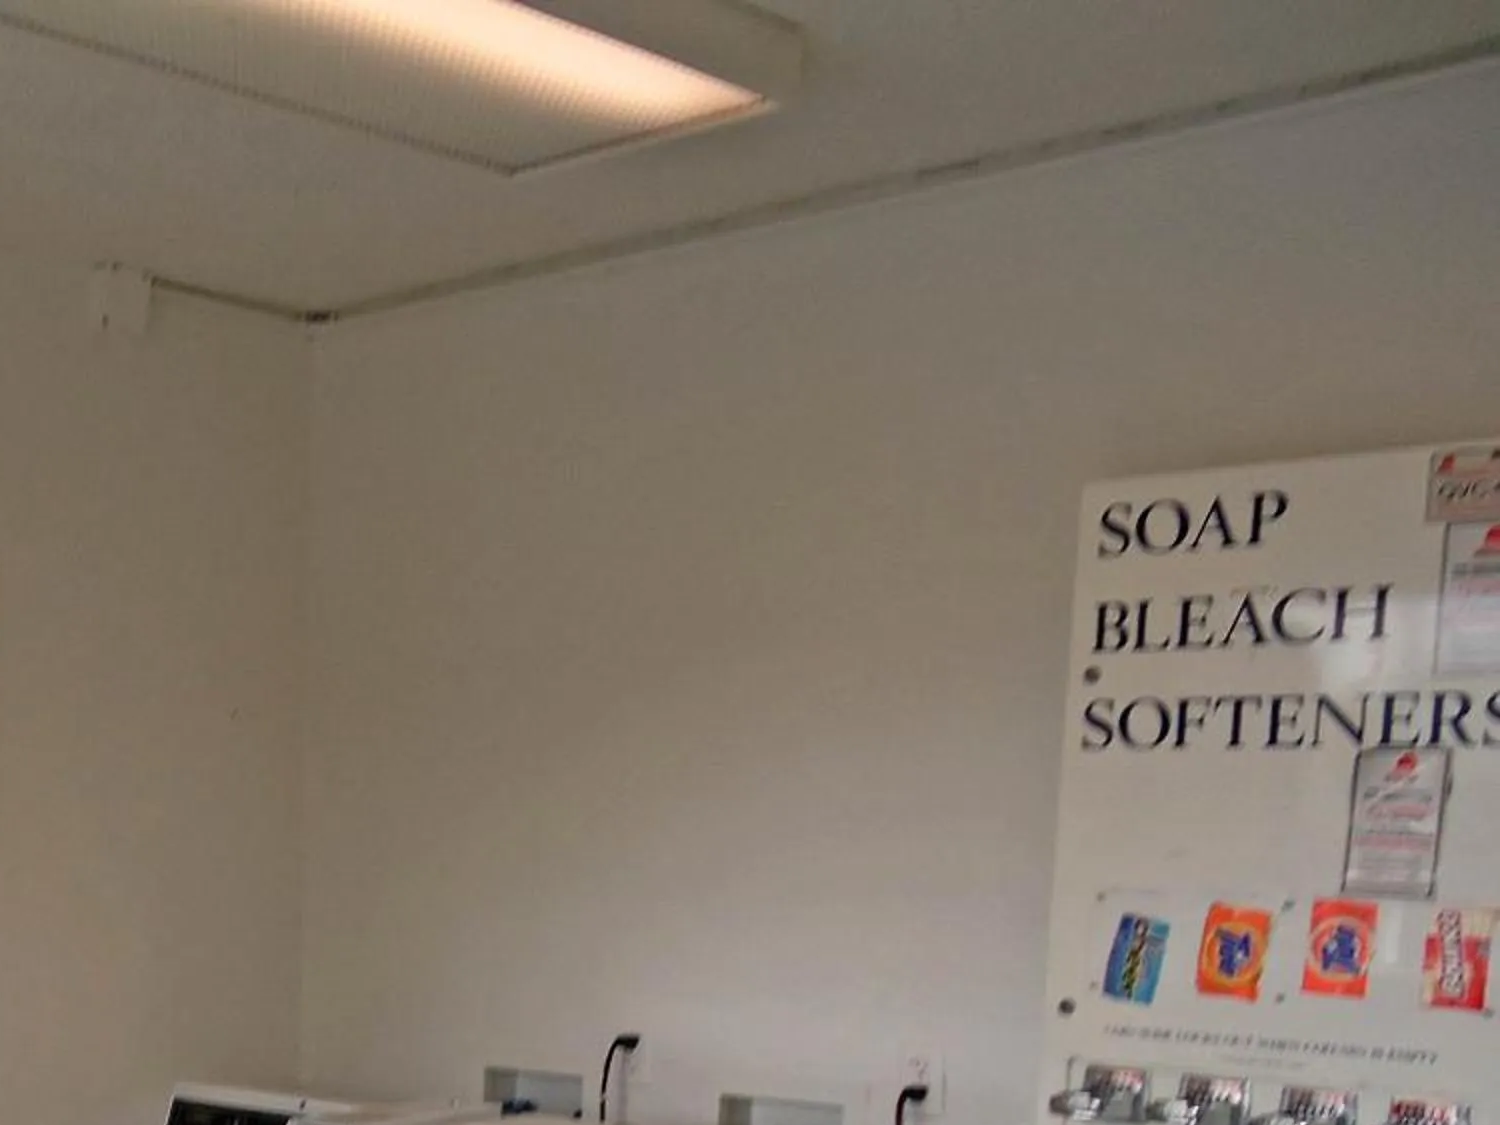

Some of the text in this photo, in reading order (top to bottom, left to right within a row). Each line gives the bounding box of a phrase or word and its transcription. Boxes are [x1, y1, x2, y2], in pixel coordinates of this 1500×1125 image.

[1097, 489, 1290, 559] SOAP
[1091, 582, 1394, 654] BLEACH
[1081, 690, 1500, 751] SOFTENERS
